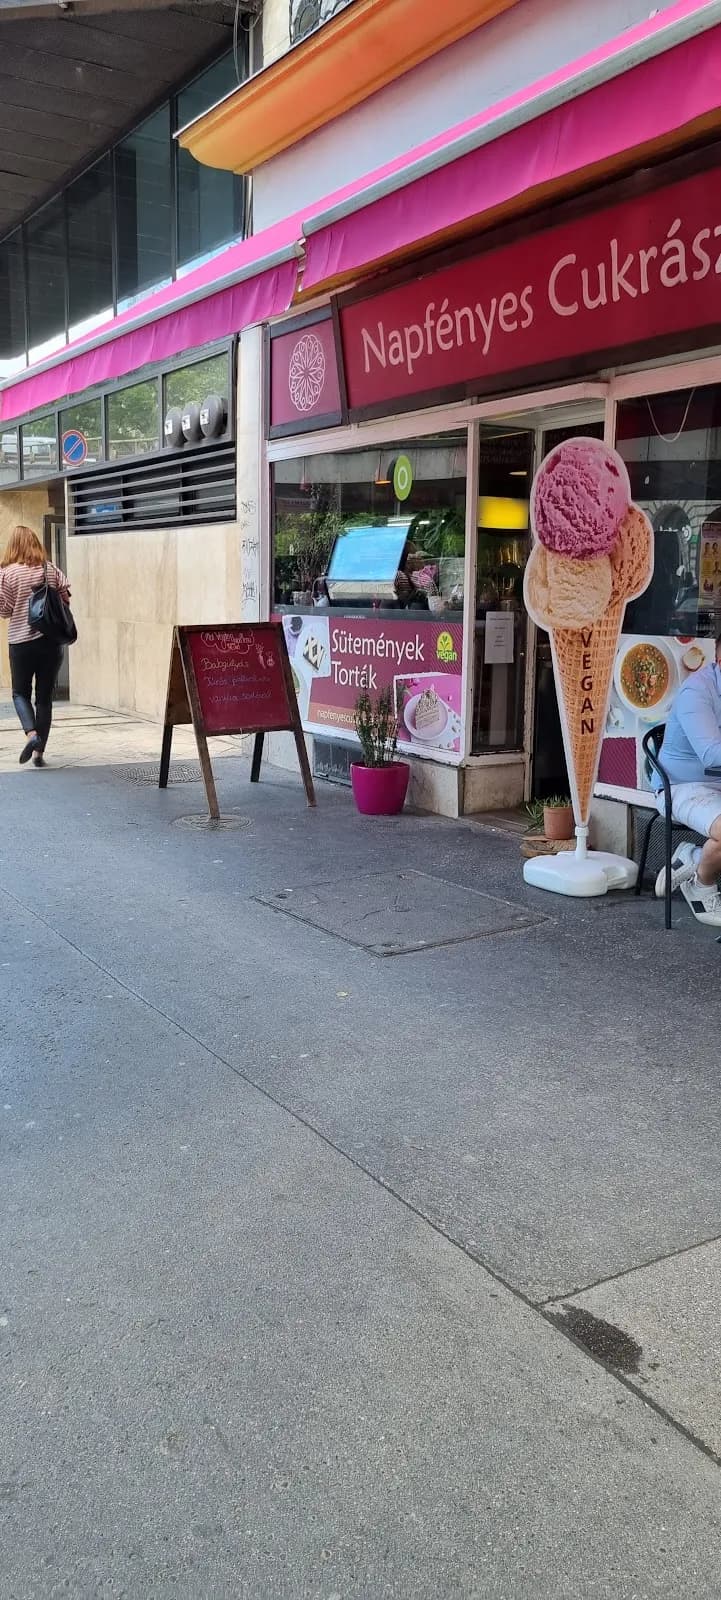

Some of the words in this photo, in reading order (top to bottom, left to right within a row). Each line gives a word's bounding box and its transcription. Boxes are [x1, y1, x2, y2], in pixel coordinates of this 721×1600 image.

[361, 285, 534, 375] Napfényes
[332, 629, 424, 664] Sütemények
[437, 651, 457, 663] vegan
[332, 662, 377, 688] Torták
[580, 631, 594, 735] VEGAN
